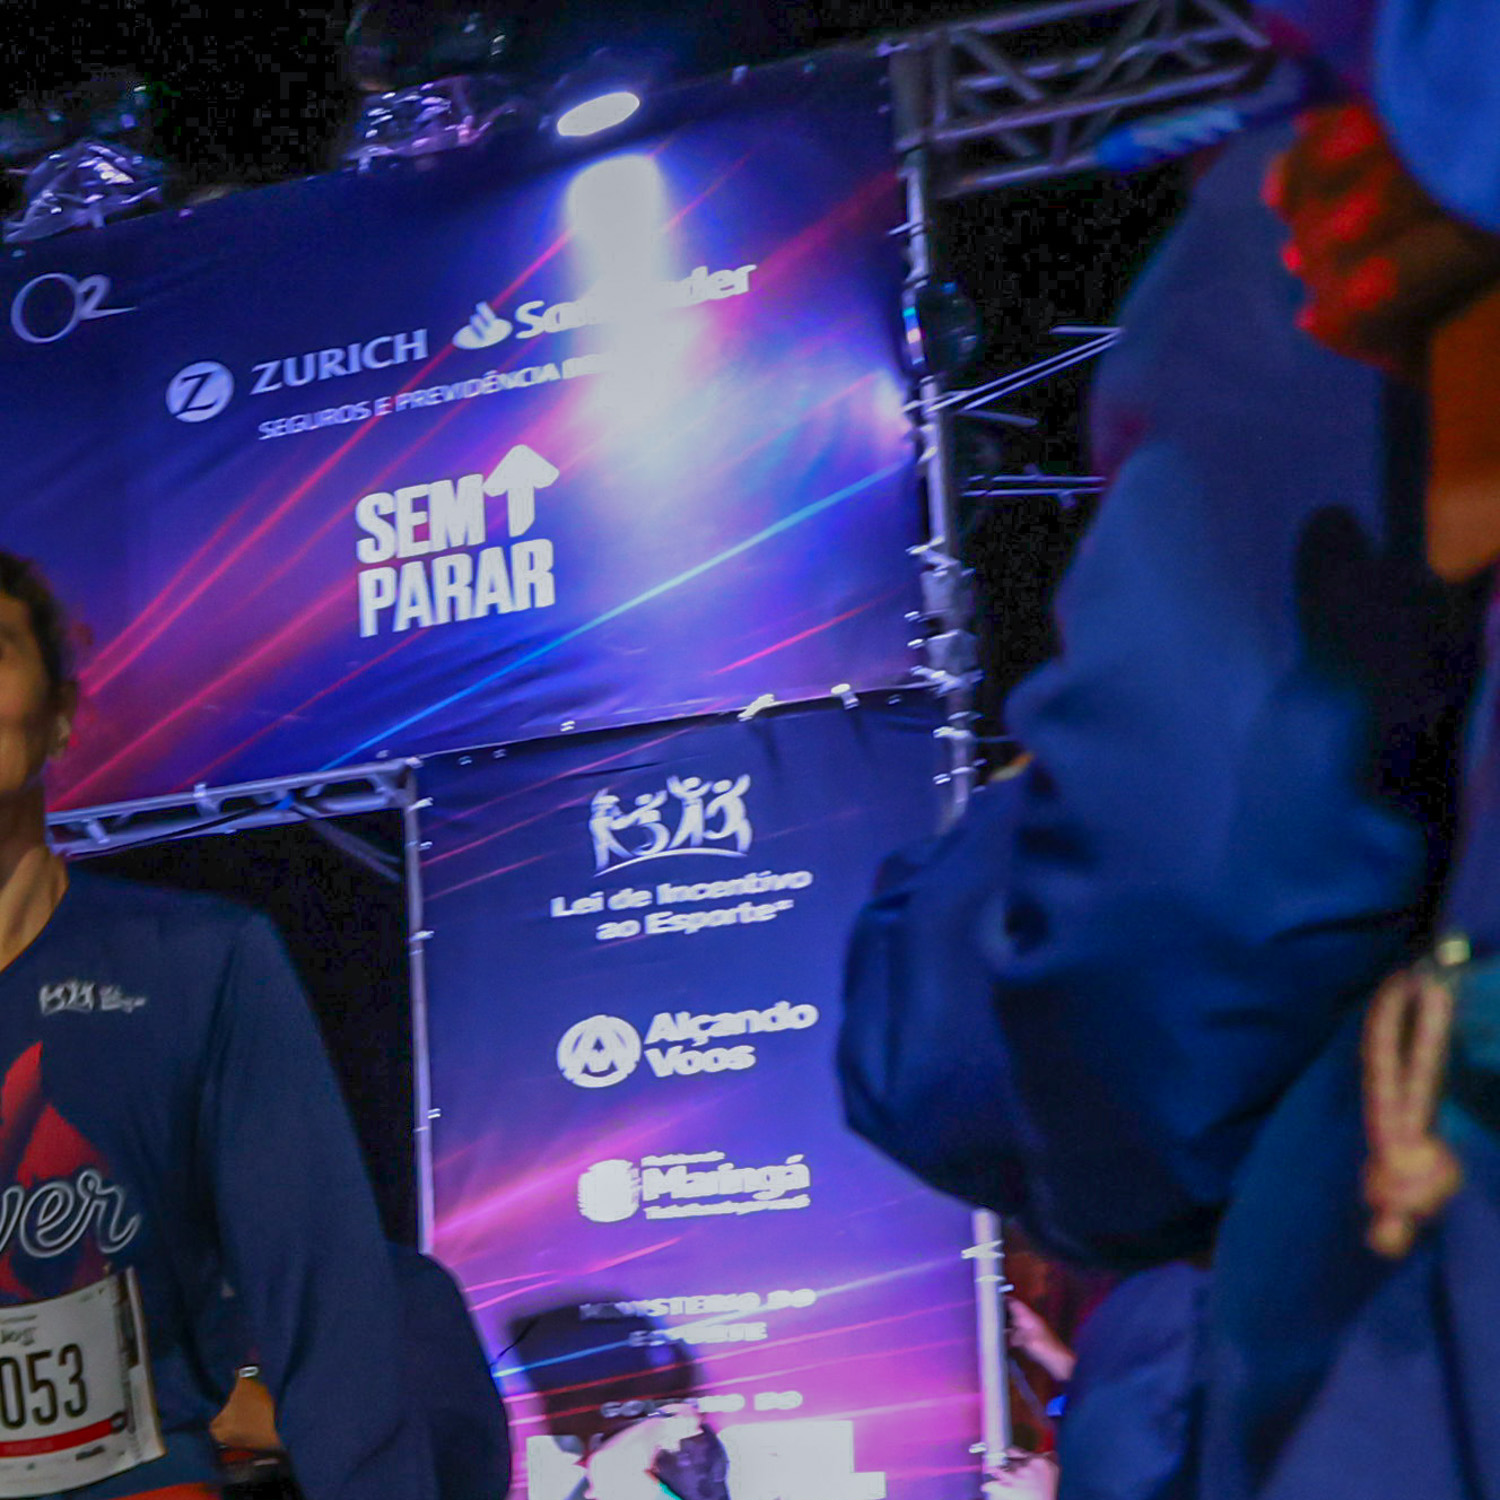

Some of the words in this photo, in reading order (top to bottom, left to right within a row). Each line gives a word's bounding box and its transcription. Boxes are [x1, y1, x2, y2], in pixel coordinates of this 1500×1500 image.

[514, 264, 757, 339] Sader
[250, 328, 428, 394] ZURICH
[258, 400, 372, 440] SEGUROS
[374, 395, 393, 417] E
[355, 473, 486, 564] SEM
[358, 538, 556, 638] PARAR
[551, 892, 604, 918] Lei
[608, 887, 653, 911] de
[656, 870, 813, 905] Incentivo
[595, 919, 641, 940] ao
[644, 1001, 819, 1047] Alçando
[644, 1045, 756, 1078] Voos
[642, 1154, 811, 1201] Maringá
